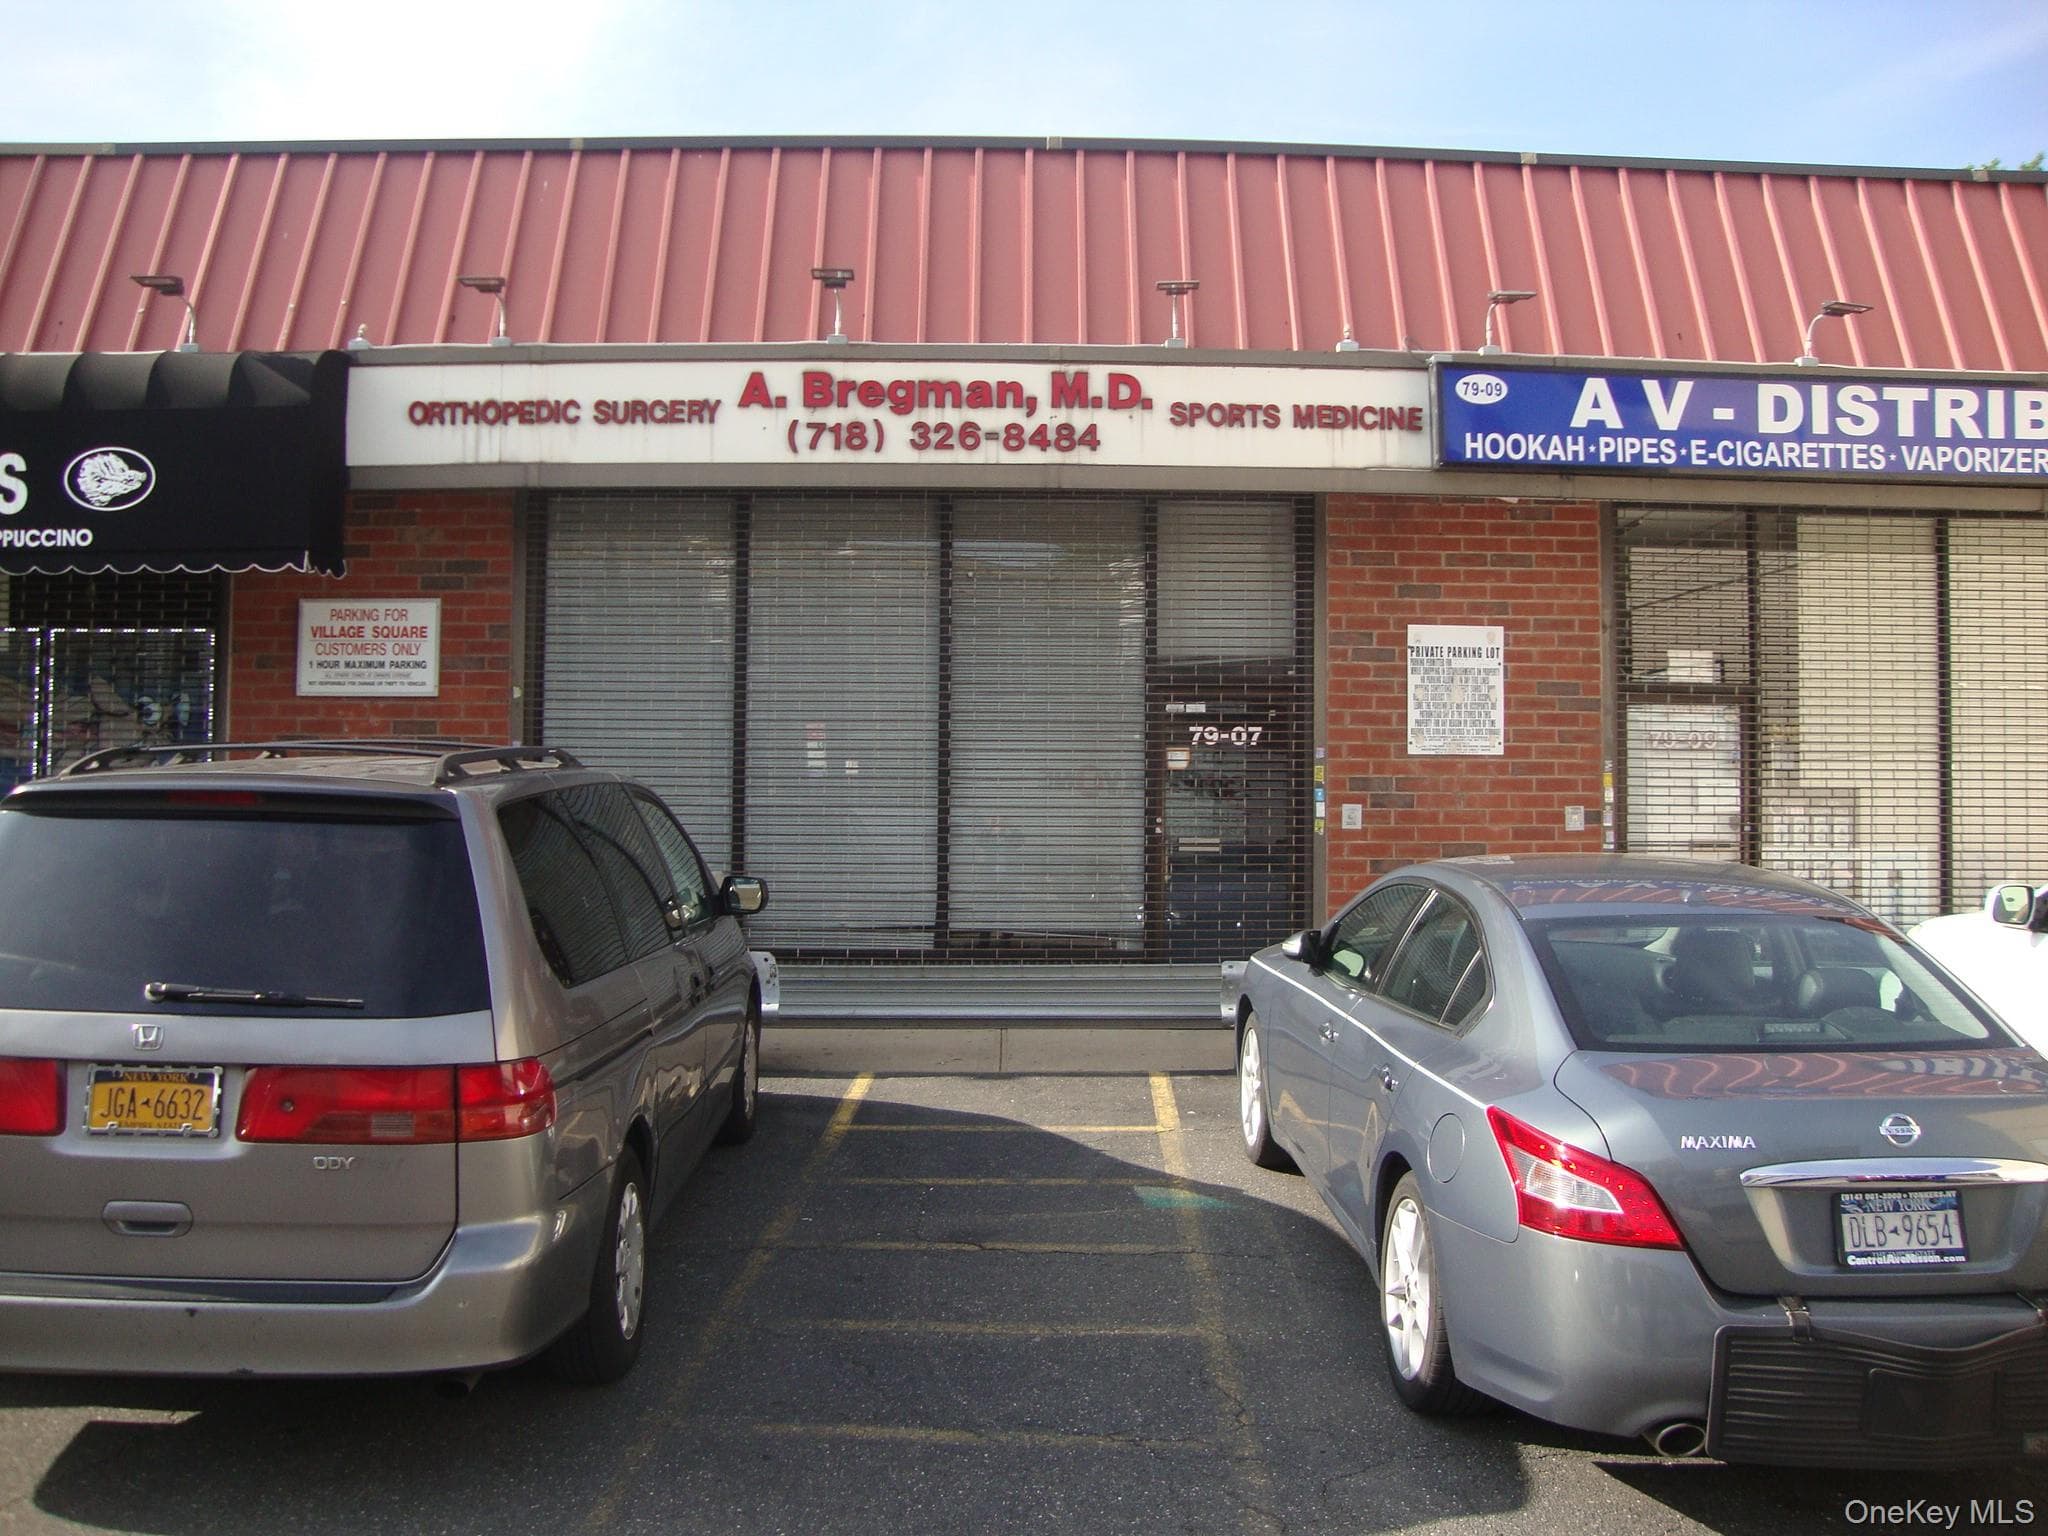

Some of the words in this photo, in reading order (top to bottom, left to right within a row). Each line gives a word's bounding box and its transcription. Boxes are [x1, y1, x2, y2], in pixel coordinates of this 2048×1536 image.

[737, 371, 787, 409] A.
[802, 371, 1038, 418] Bregman,
[1051, 371, 1153, 411] M.D.
[1463, 381, 1502, 397] 79-09
[408, 400, 581, 426] ORTHOPEDIC
[593, 399, 722, 425] SURGERY
[1169, 401, 1282, 429] SPORTS
[1292, 403, 1424, 432] MEDICINE
[1757, 383, 2048, 440] DISTRIB
[787, 418, 885, 453] (718)
[909, 421, 1101, 453] 326-8484
[1464, 432, 1585, 462] HOOKAH
[1600, 436, 1677, 465] PIPES
[1690, 439, 1887, 471] E-CIGARETTES
[1900, 445, 2048, 474] VAPORIZER
[0, 528, 94, 548] PUCCINO
[329, 608, 380, 622] PARKING
[384, 608, 409, 622] FOR
[310, 626, 366, 638] VILLAGE
[372, 626, 428, 639] SQUARE
[314, 642, 387, 656] CUSTOMERS
[392, 643, 422, 656] ONLY
[1409, 646, 1444, 658] PRIVATE
[1447, 646, 1483, 658] PARKING
[1485, 647, 1501, 659] LOT
[308, 660, 314, 669] 1
[316, 660, 341, 669] HOUR
[344, 660, 386, 669] MAXIMUM
[389, 660, 427, 670] PARKING
[1188, 726, 1263, 746] 79-07
[158, 1072, 188, 1083] YORK
[1680, 1135, 1757, 1151] MAXIMA
[313, 1156, 356, 1170] ODY
[1866, 1199, 1894, 1212] NEW
[1897, 1198, 1932, 1211] YORK
